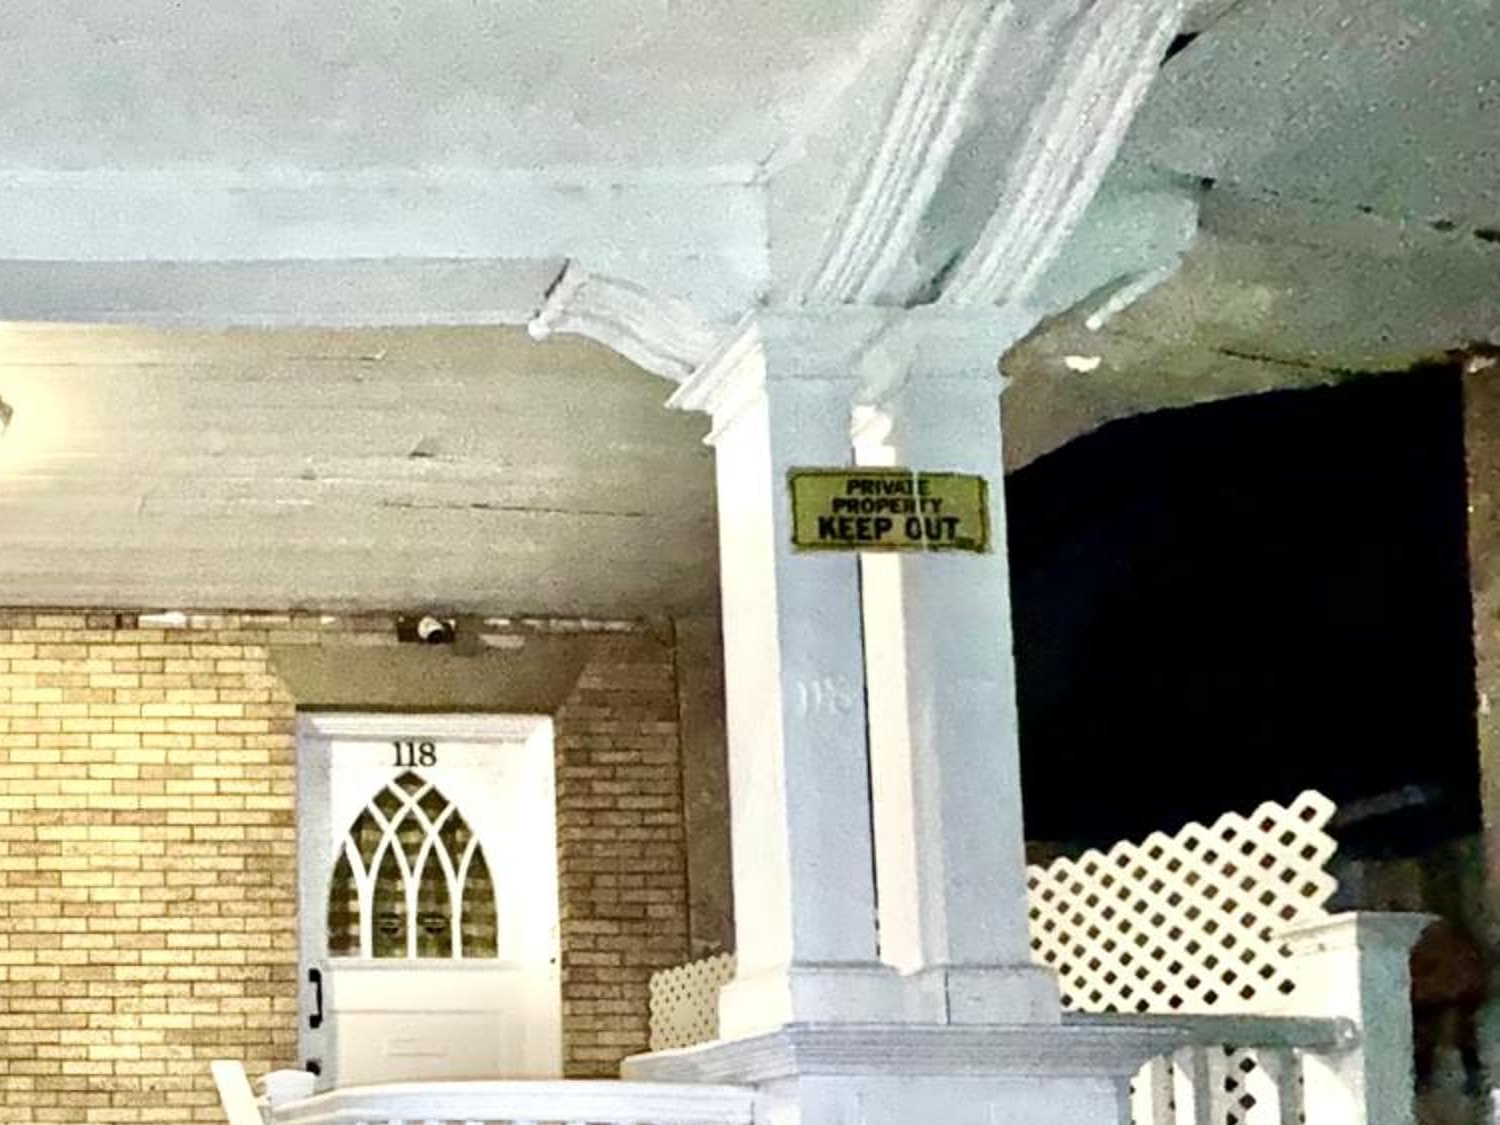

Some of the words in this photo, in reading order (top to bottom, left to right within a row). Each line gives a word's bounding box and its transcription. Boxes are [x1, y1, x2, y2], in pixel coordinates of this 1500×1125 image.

[846, 479, 931, 497] PRIVATE
[832, 497, 944, 515] PROPERTY
[817, 516, 893, 541] KEEP
[904, 517, 961, 541] OUT
[392, 740, 437, 767] 118
